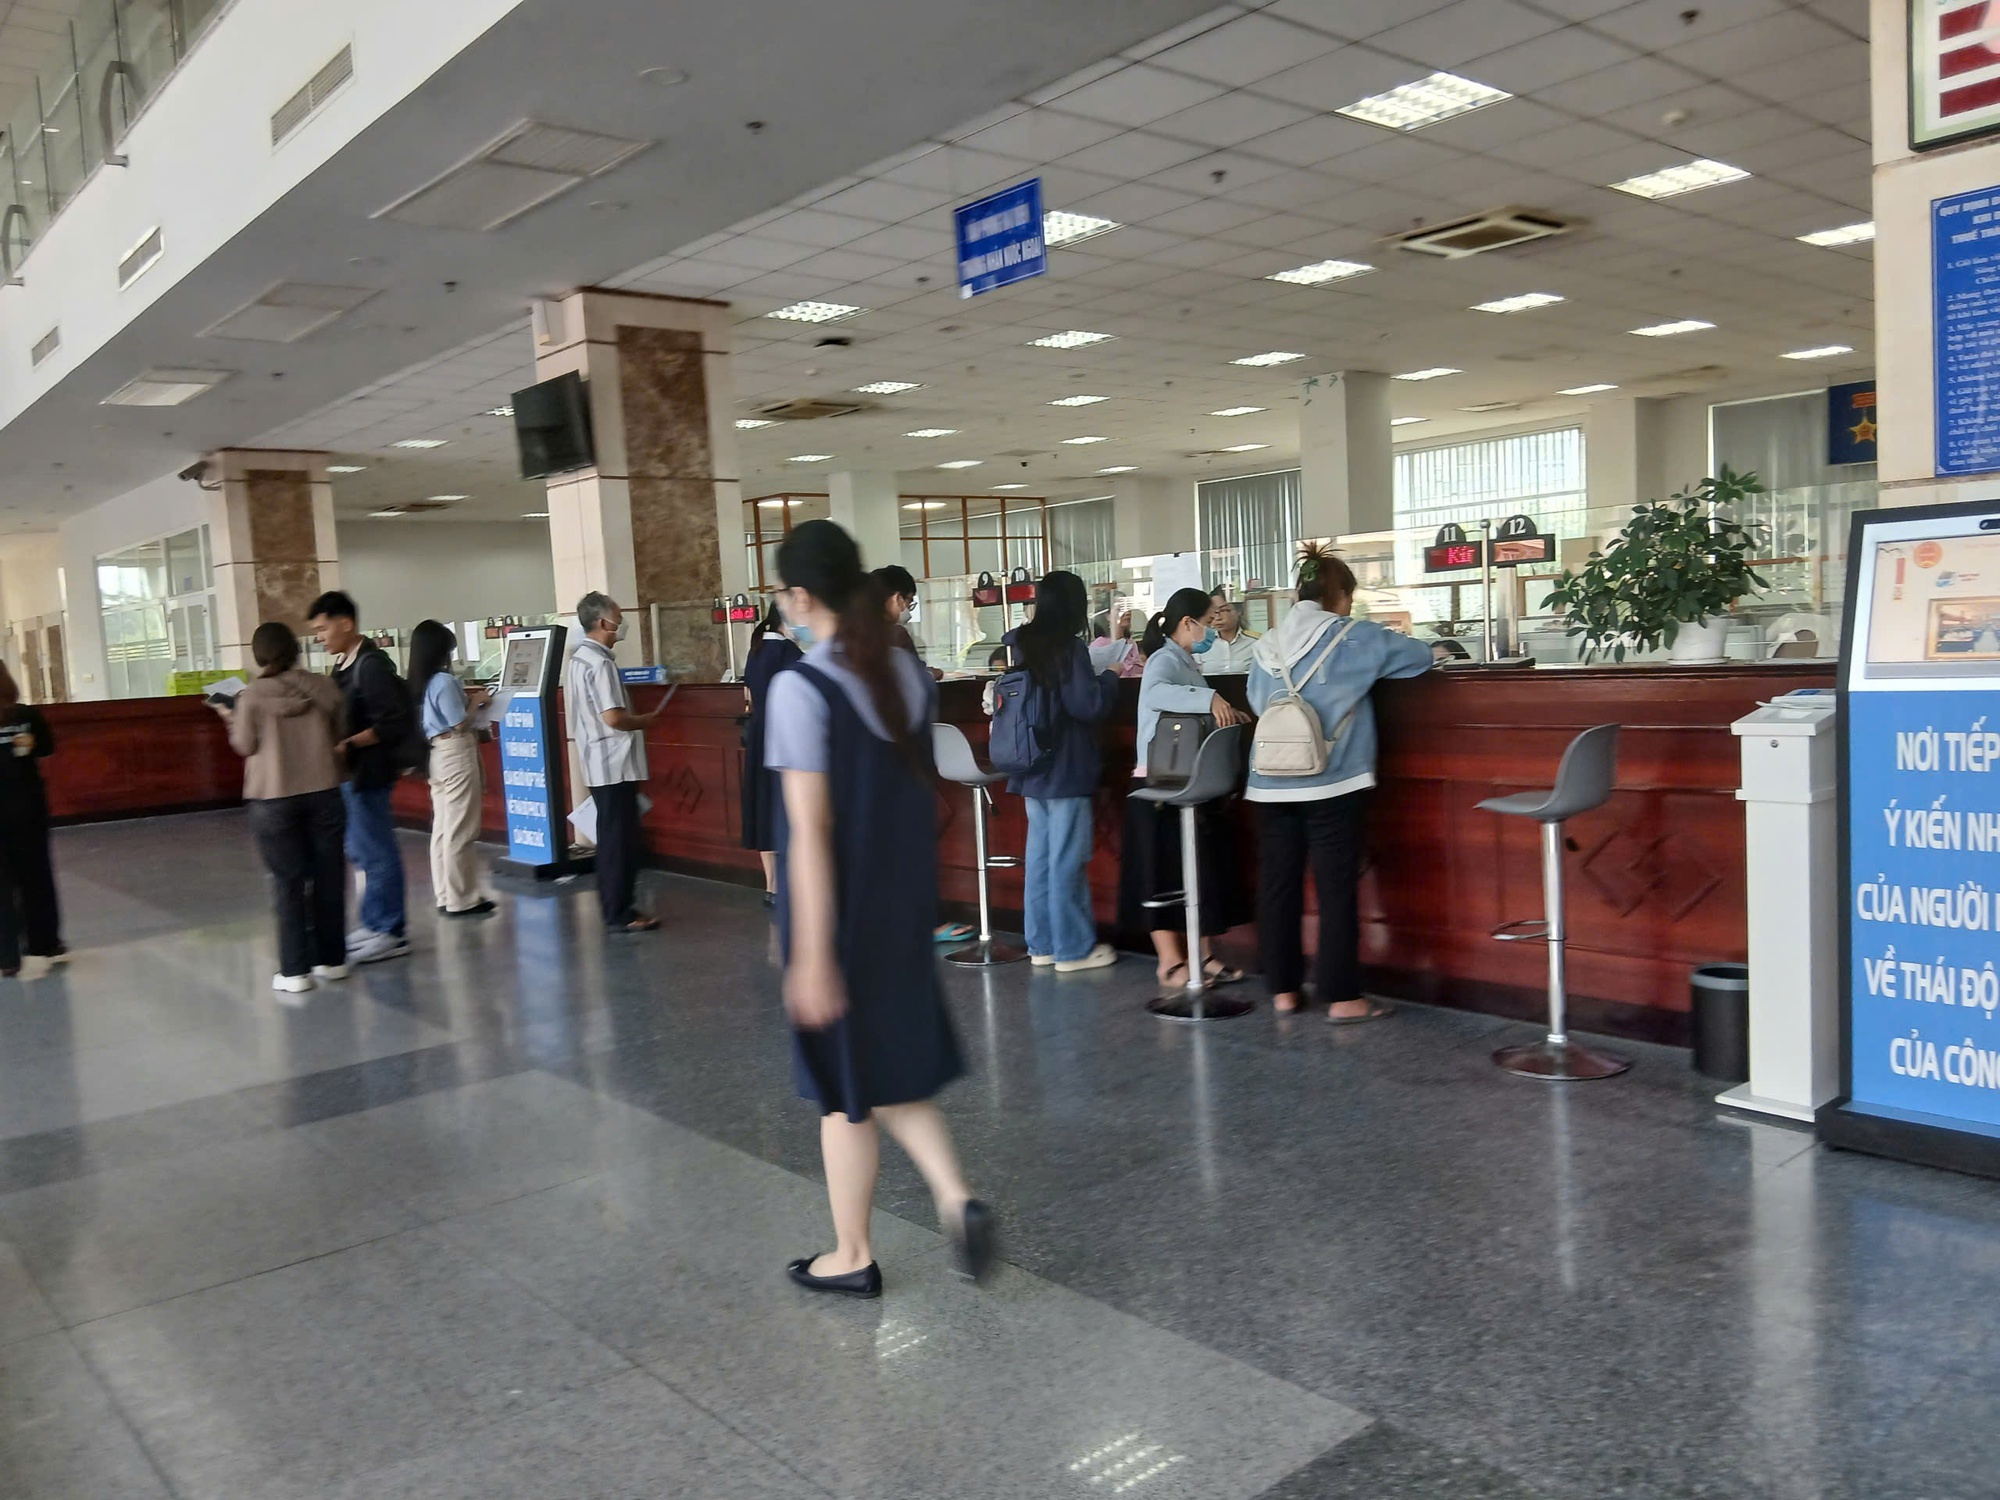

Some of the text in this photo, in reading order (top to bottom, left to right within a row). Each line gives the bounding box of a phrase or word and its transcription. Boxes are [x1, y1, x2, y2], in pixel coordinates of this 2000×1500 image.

[1443, 527, 1457, 542] 11
[1508, 518, 1527, 535] 12
[982, 573, 989, 586] 9
[1014, 570, 1025, 582] 10
[737, 595, 744, 606] 8
[1896, 716, 2000, 772] NƠI TIẾP
[1883, 799, 1902, 846] Ý
[1905, 795, 1962, 851] KIẾN
[1857, 873, 1907, 924] CỦA
[1910, 881, 1989, 931] NGƯỜI
[1863, 945, 1999, 1020] VỀ THÁI ĐỘ
[1889, 1028, 2000, 1089] CỦA CÔN
